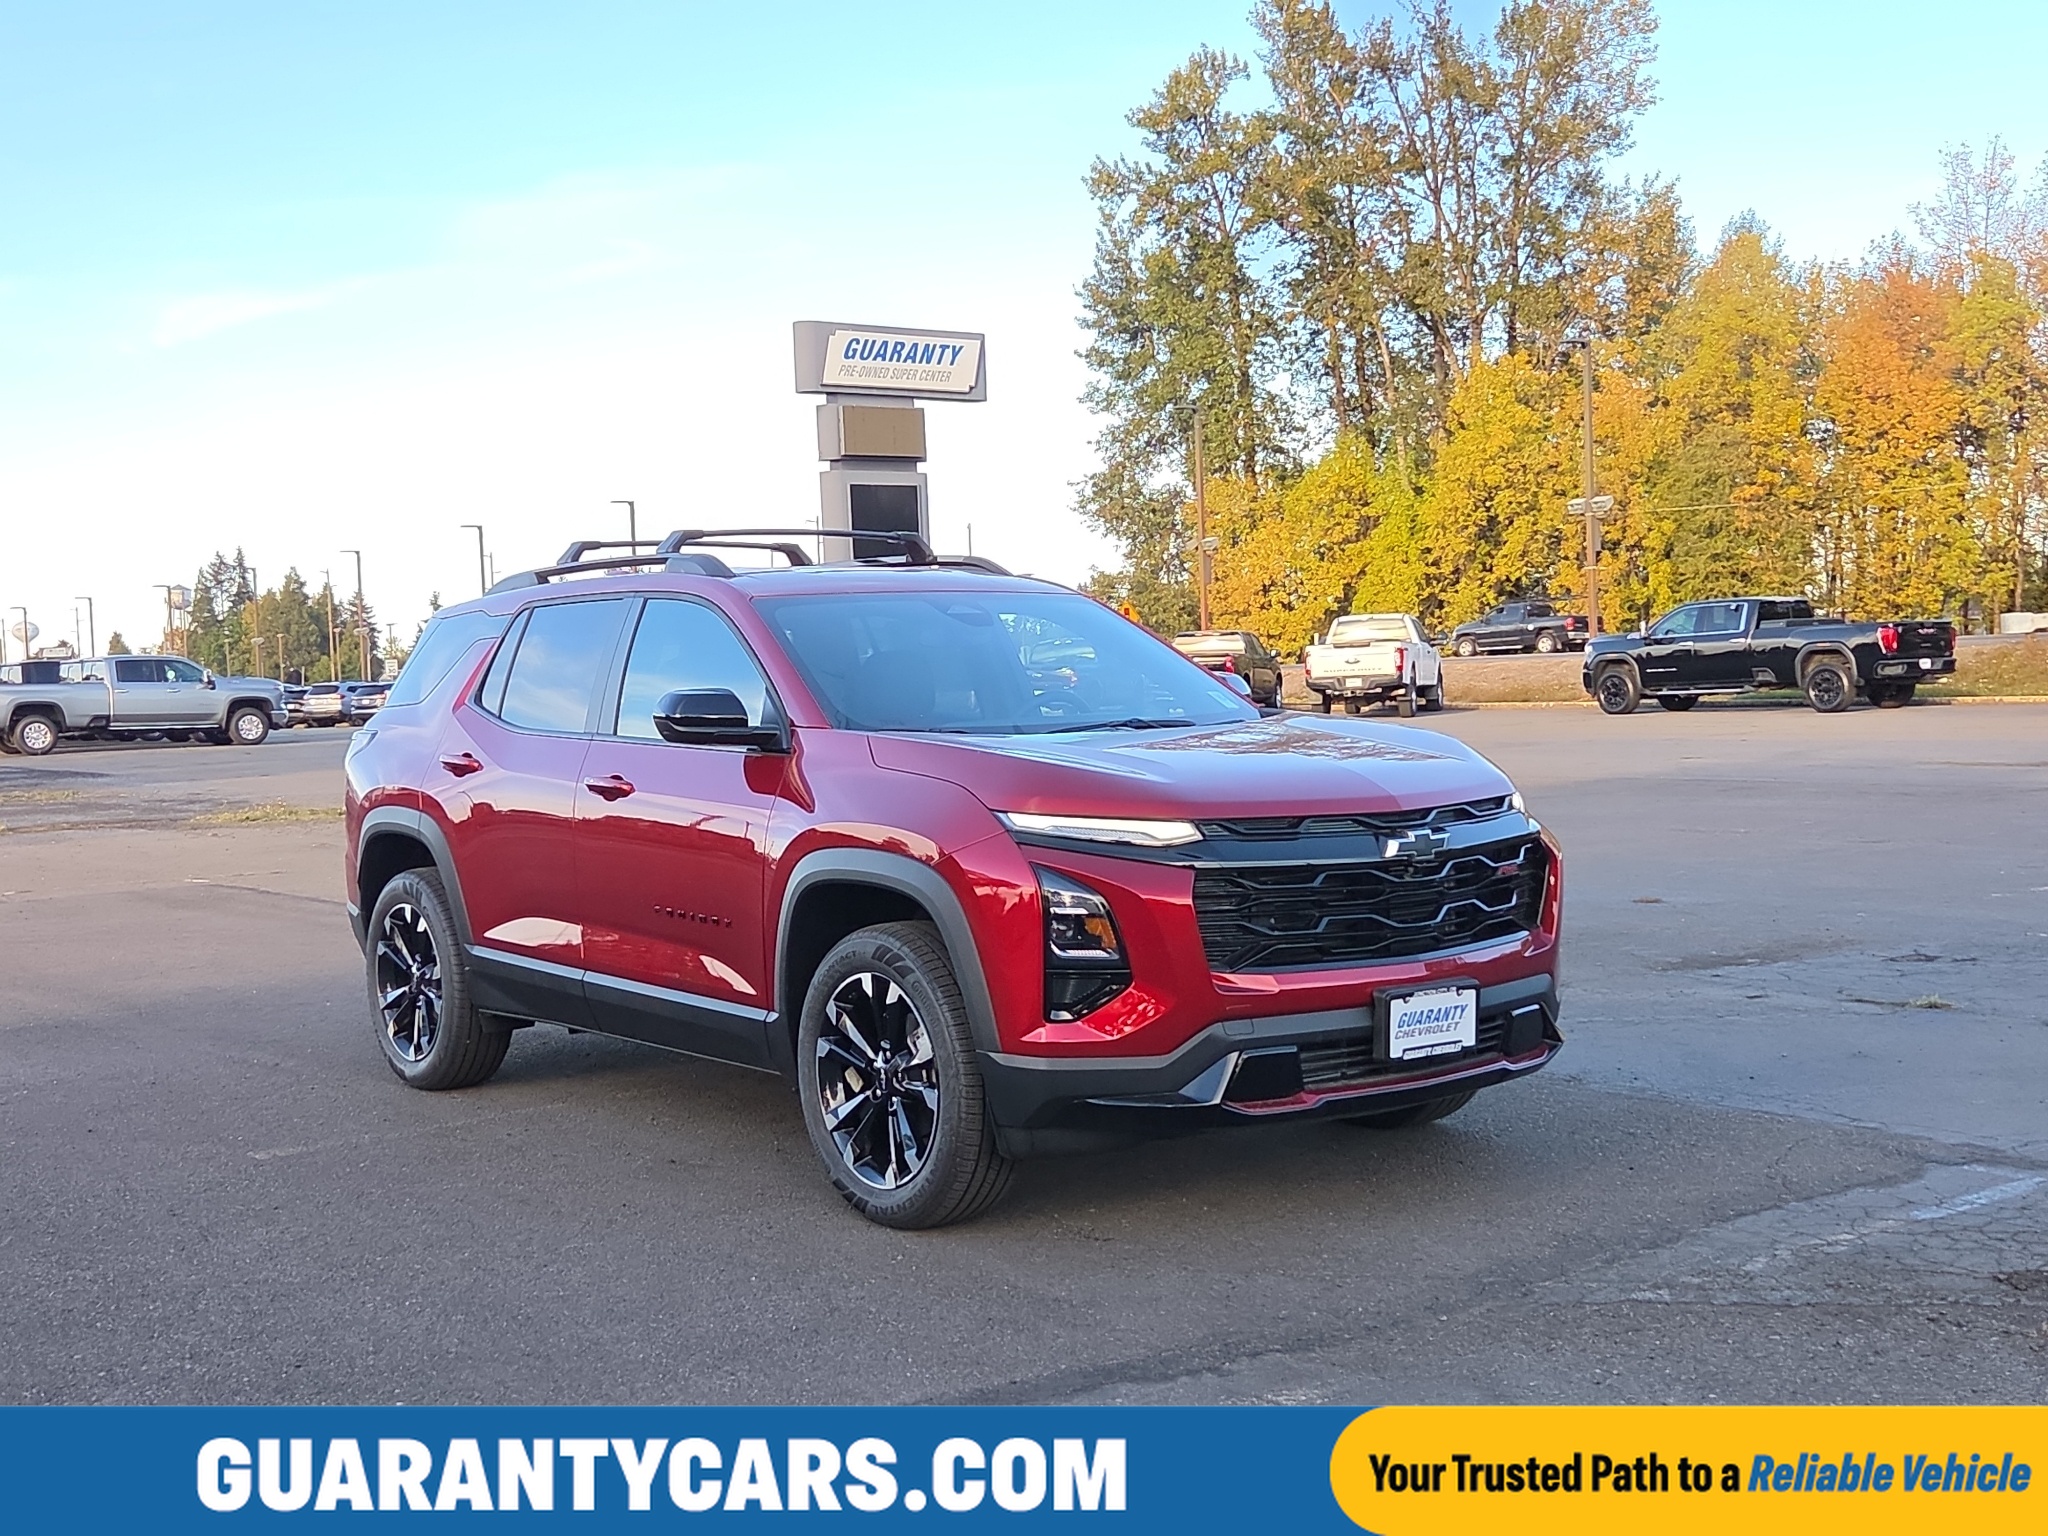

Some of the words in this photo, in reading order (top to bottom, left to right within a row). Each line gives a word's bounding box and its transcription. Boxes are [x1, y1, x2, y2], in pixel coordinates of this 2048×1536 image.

[843, 337, 965, 367] GUARANTY
[838, 364, 890, 380] PRE-OWNED
[890, 368, 918, 382] SUPER
[919, 370, 952, 383] CENTER
[1397, 1003, 1469, 1029] GUARANTY
[1394, 1021, 1461, 1040] CHEVROLET
